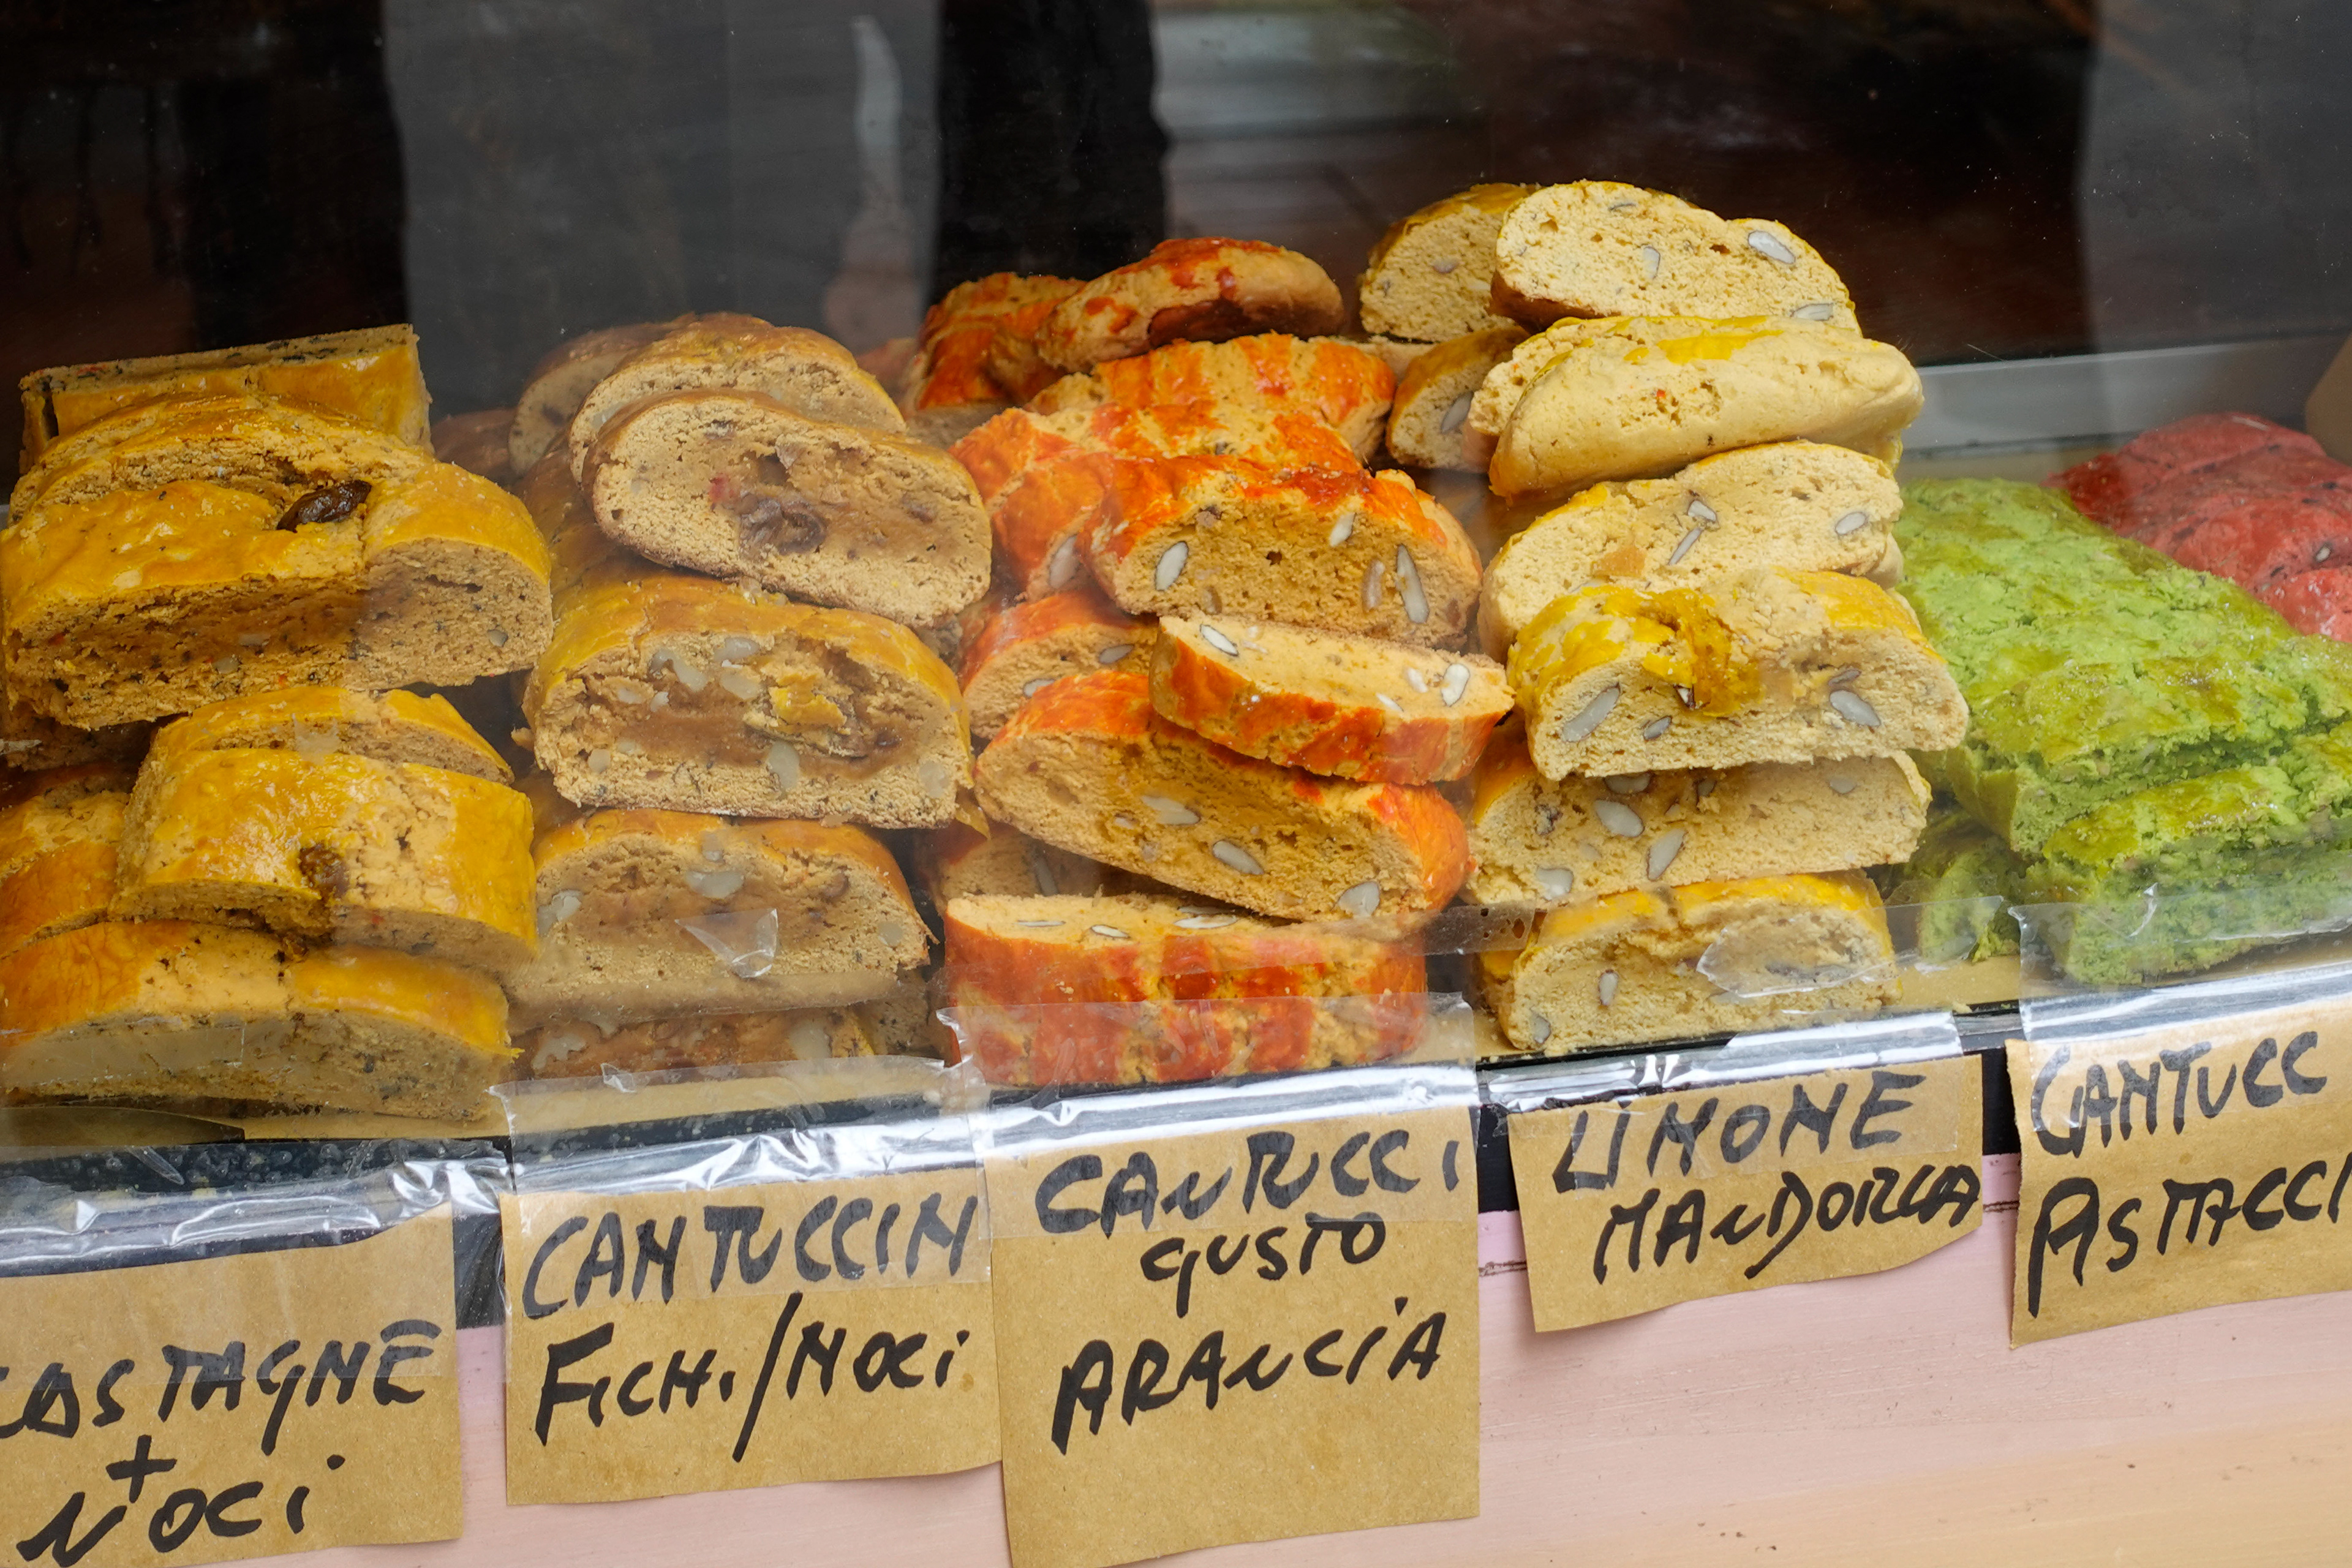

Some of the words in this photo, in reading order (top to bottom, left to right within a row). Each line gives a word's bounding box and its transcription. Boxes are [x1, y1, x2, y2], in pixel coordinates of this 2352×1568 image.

[1551, 1071, 1927, 1194] LIMONE
[1139, 1212, 1387, 1319] GUSTO
[105, 1434, 178, 1503] +
